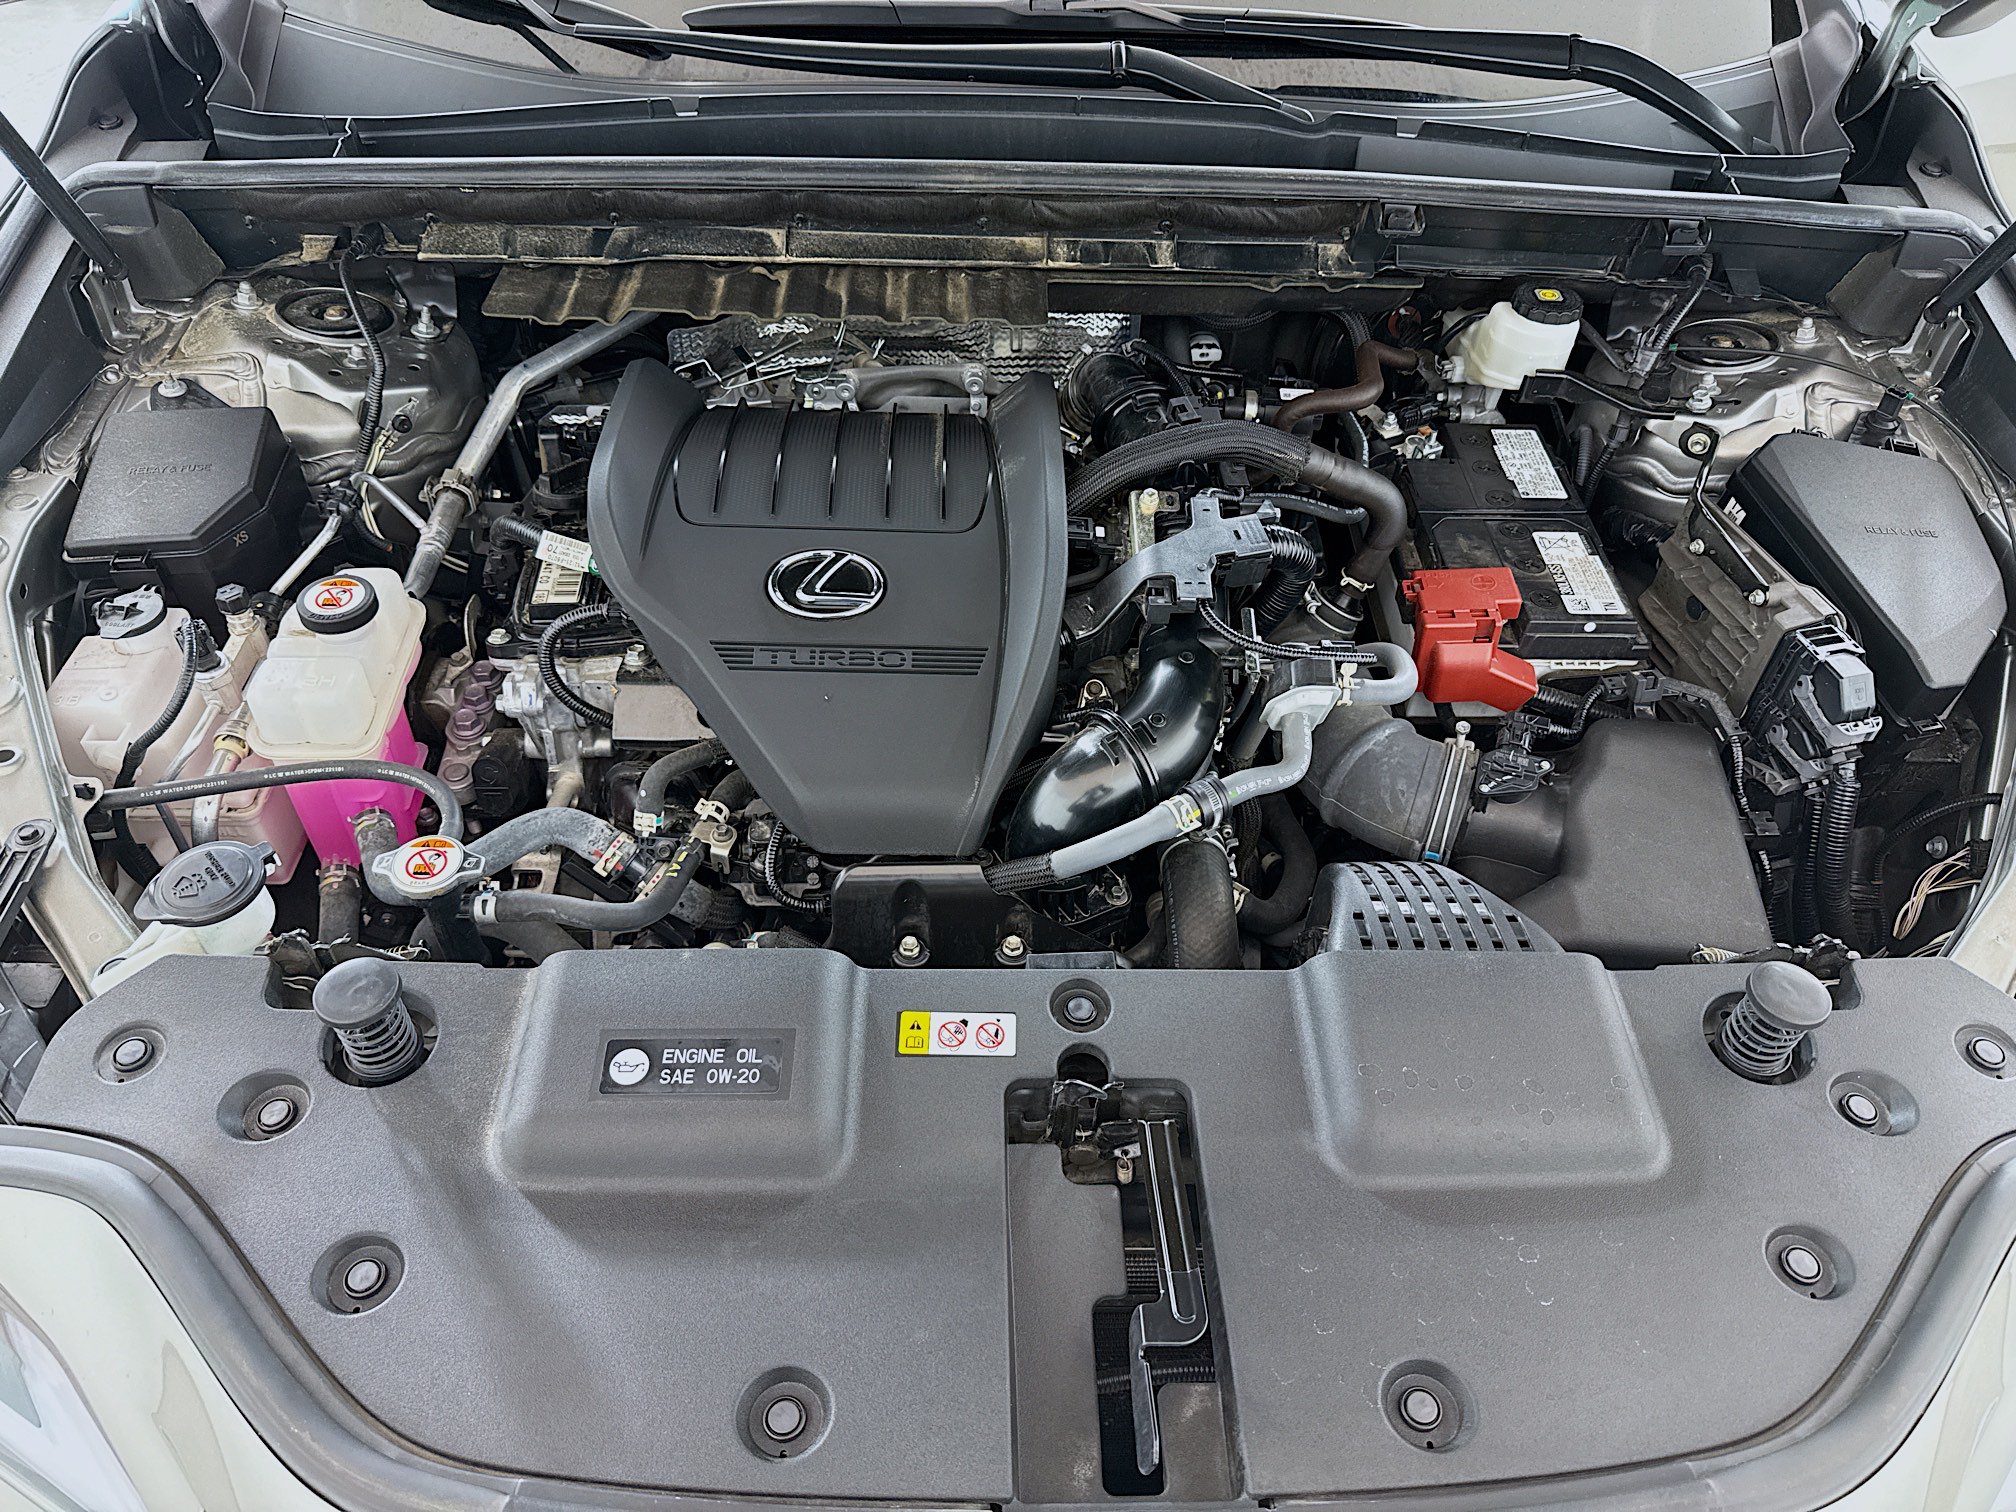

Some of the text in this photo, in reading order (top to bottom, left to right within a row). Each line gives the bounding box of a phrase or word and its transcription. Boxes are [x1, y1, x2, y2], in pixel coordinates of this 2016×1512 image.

[129, 464, 169, 475] RELAY
[180, 463, 213, 473] FUSE
[233, 530, 249, 547] XS
[1864, 525, 1899, 536] RELAY
[1909, 528, 1939, 539] FUSE
[758, 647, 907, 669] TURBO
[285, 769, 305, 777] WATER
[162, 786, 184, 794] WATER
[661, 1048, 763, 1064] ENGINE OIL
[659, 1068, 761, 1085] SAE 0W-20
